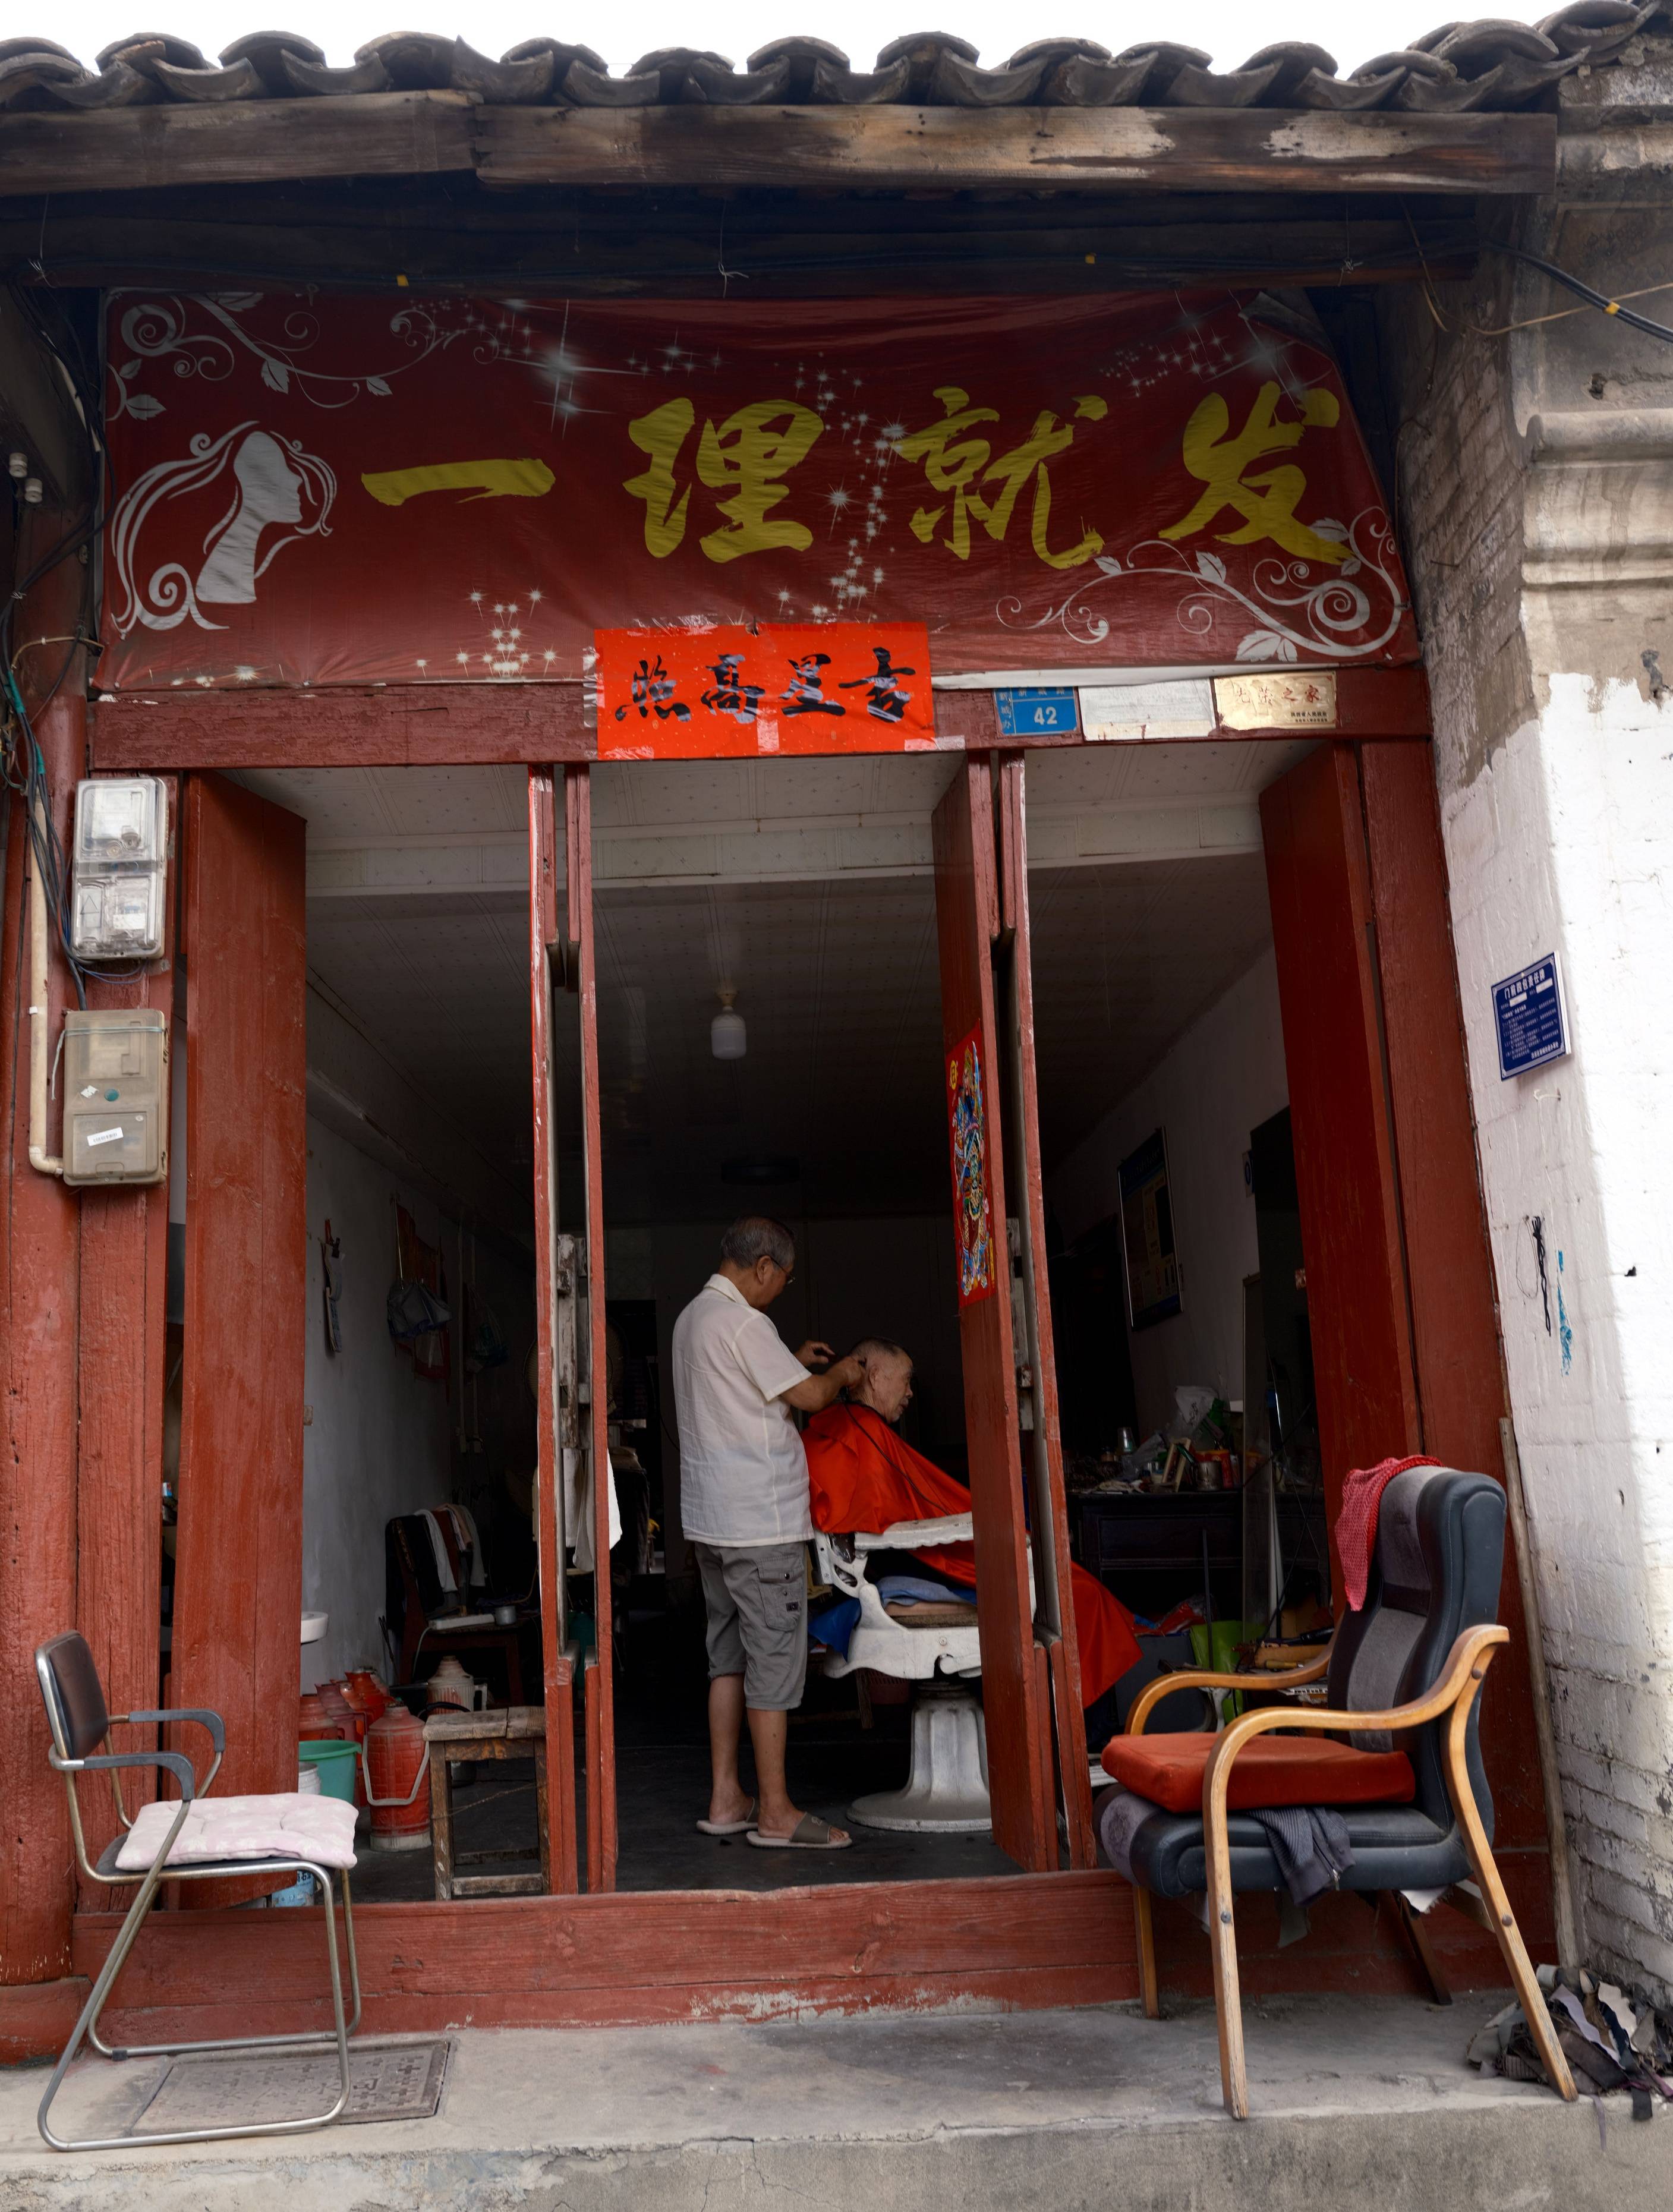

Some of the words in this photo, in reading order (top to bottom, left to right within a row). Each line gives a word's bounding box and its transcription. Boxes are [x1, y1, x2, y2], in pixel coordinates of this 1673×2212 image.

[361, 380, 1356, 569] 一理就发
[1034, 706, 1058, 726] 42
